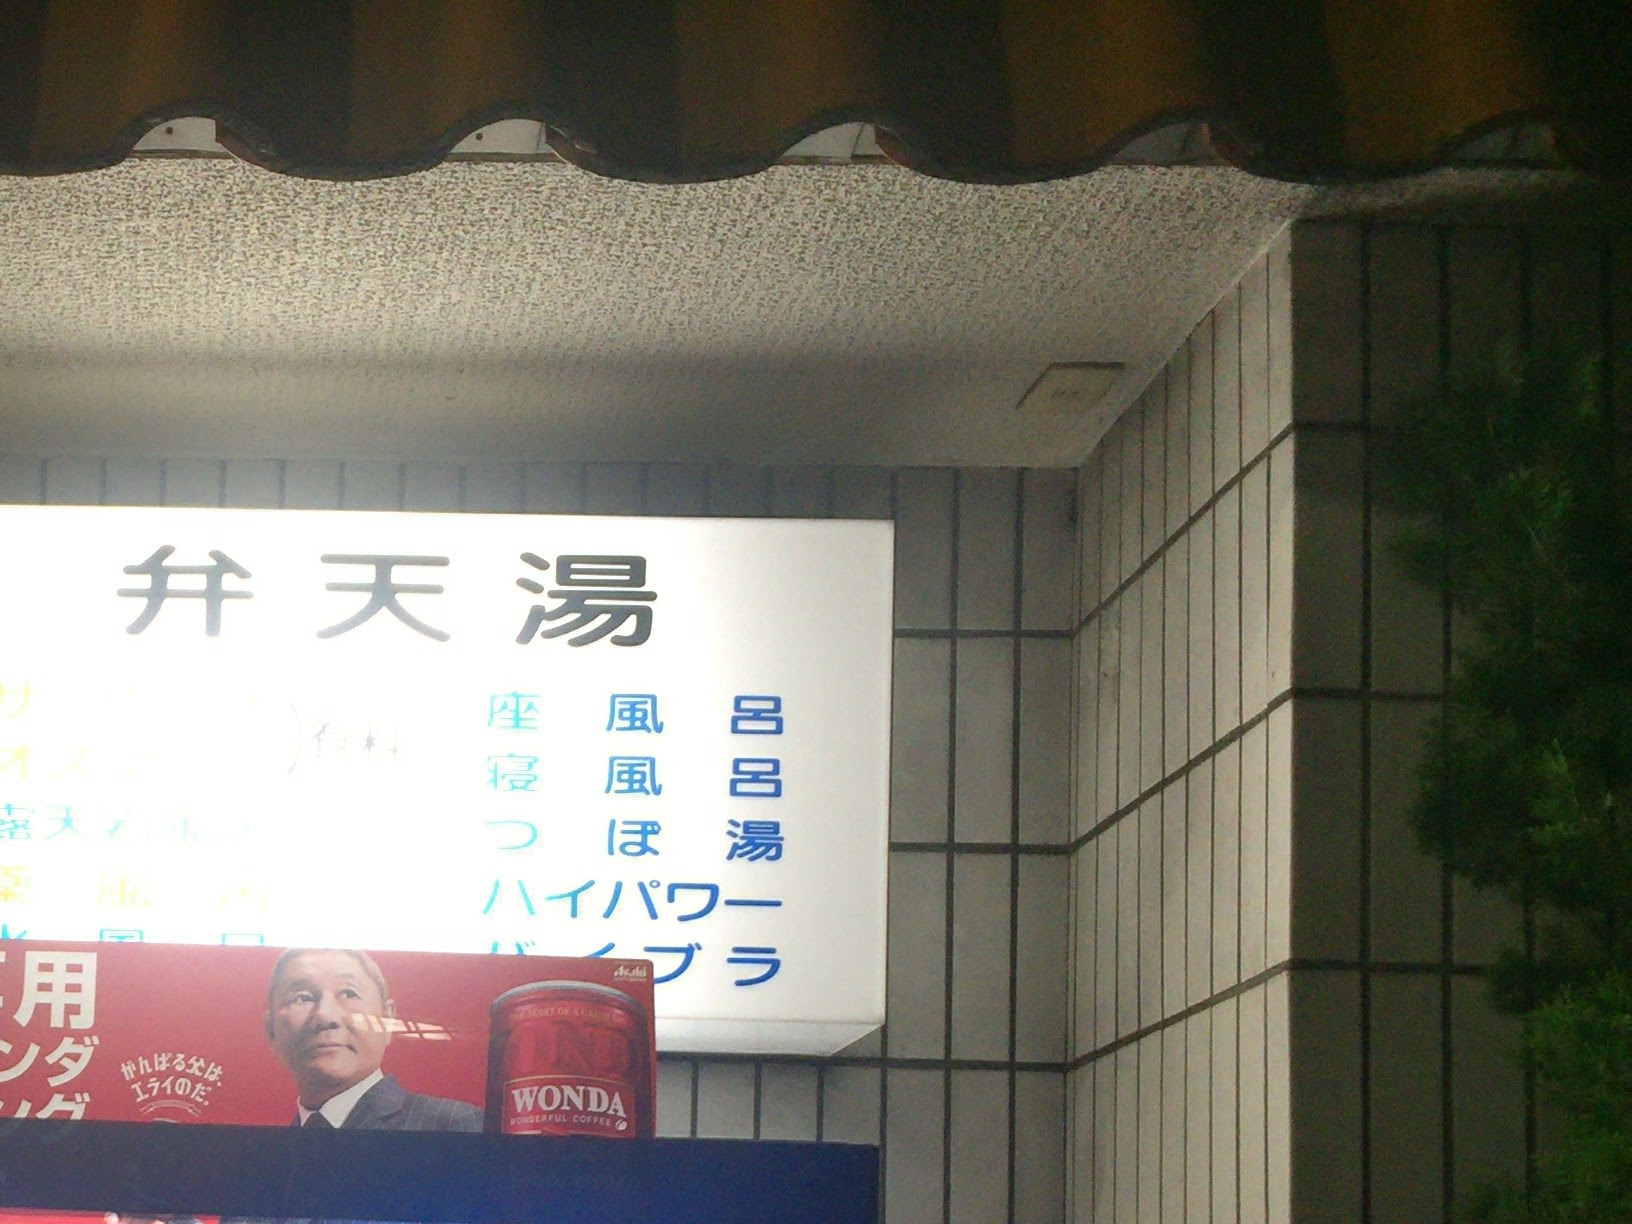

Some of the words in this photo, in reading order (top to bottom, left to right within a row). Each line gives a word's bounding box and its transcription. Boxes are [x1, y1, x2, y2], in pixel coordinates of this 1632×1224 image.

[116, 543, 658, 648] 弁天湯
[486, 691, 784, 736] 座風呂
[485, 752, 783, 798] 寝風呂
[483, 818, 785, 862] つぼ湯
[481, 878, 783, 922] ハイパワー
[133, 1074, 211, 1106] エライのだ。
[511, 1084, 627, 1119] WONDA
[509, 1113, 568, 1127] WONDERFUL
[571, 1113, 611, 1127] COFFEE
